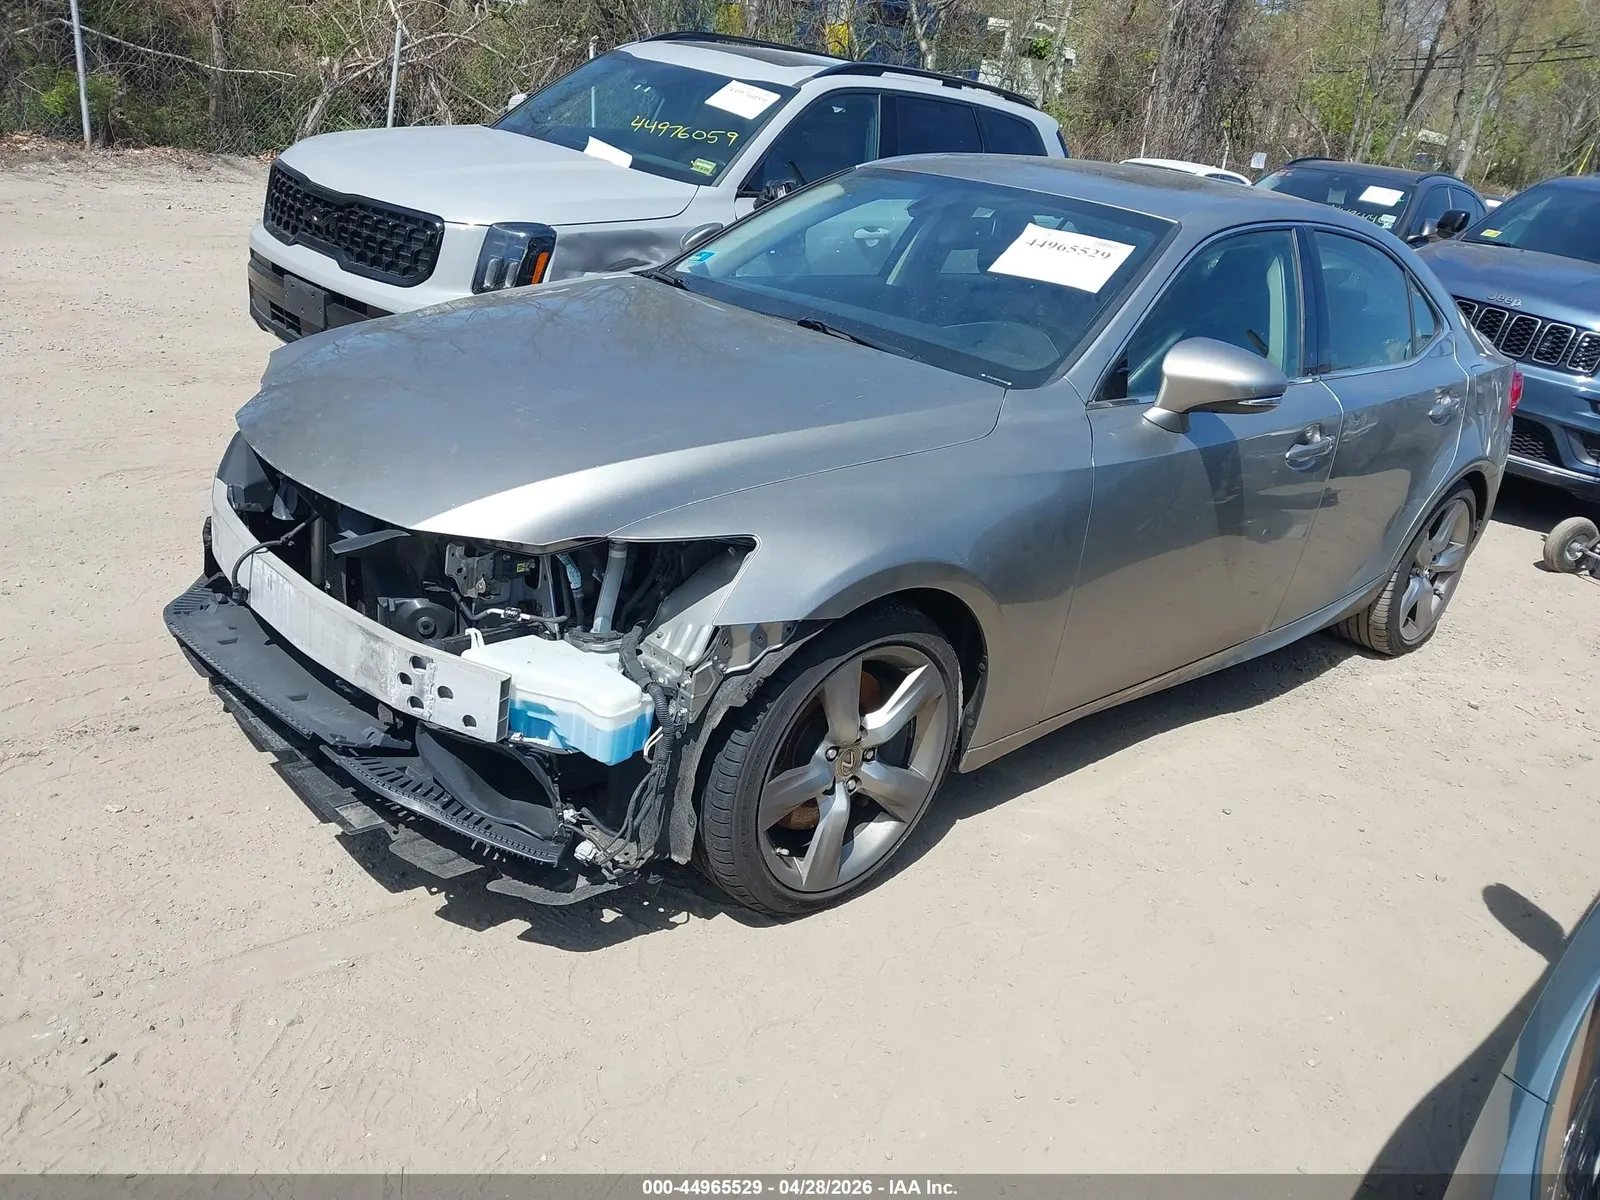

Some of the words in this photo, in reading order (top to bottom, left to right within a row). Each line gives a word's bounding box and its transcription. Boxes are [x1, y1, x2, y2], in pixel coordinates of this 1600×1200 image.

[631, 115, 739, 147] 44976059
[1026, 238, 1112, 260] 44965529
[1487, 292, 1522, 307] Jeep
